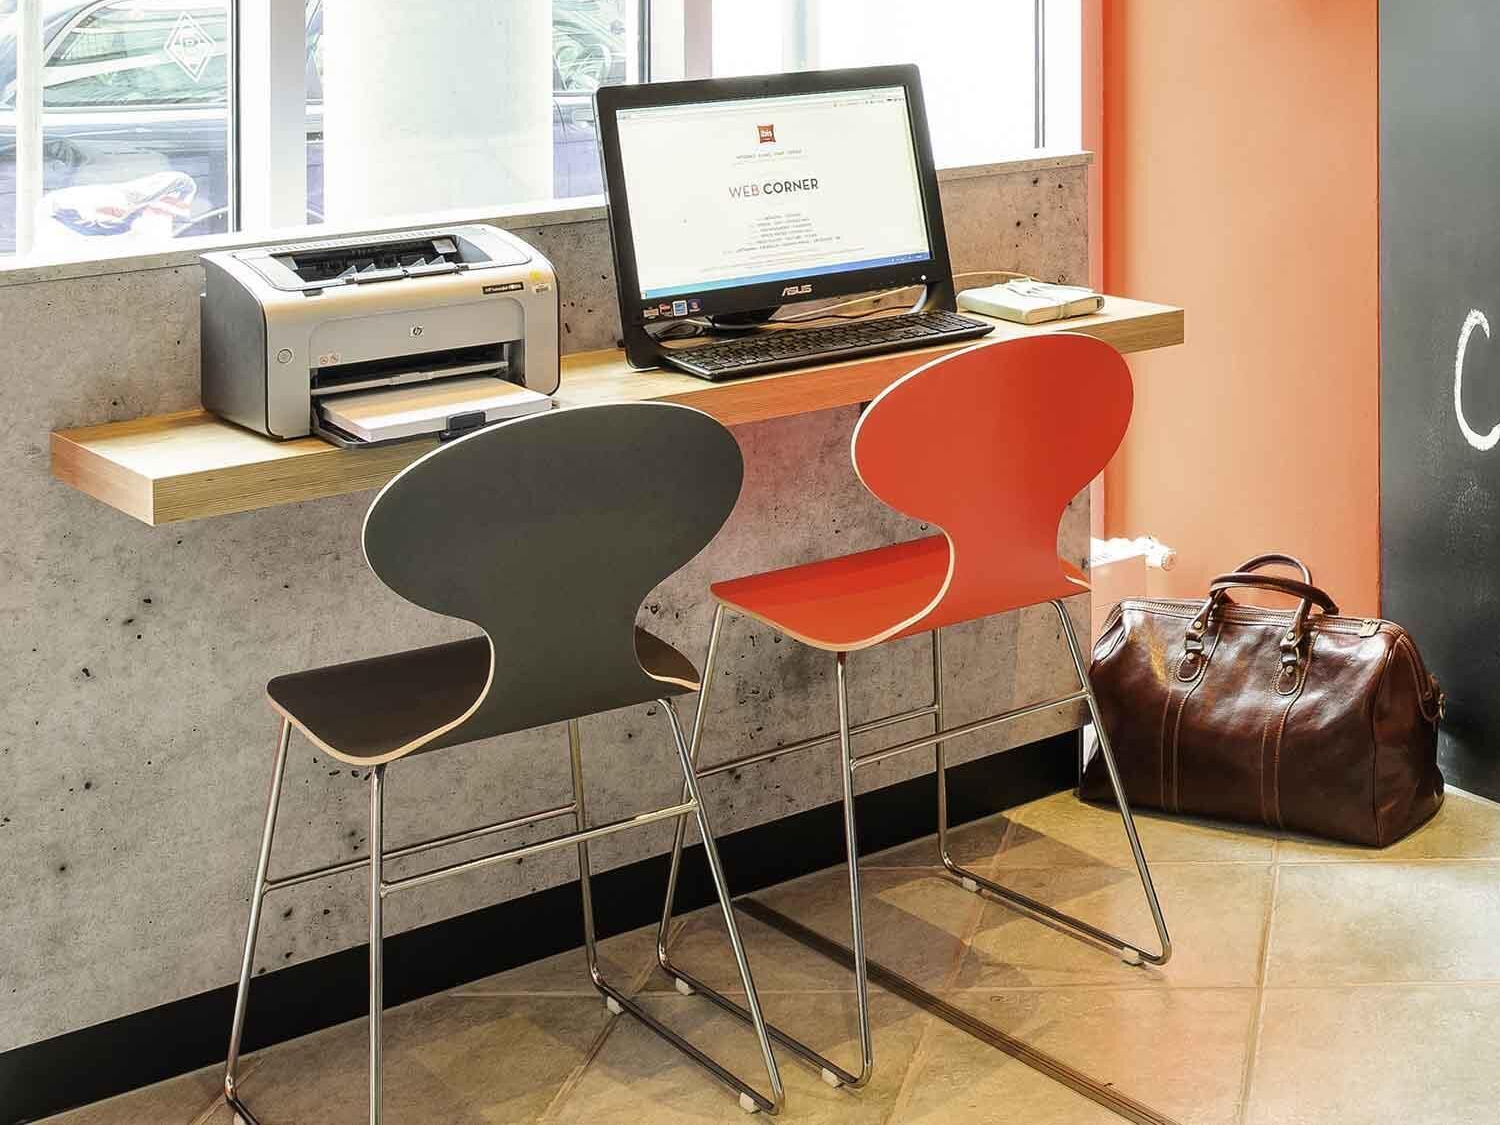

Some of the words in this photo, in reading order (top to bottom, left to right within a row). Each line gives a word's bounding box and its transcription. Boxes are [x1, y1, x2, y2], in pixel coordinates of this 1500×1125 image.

[728, 184, 760, 199] WEB
[762, 177, 819, 195] CORNER
[781, 284, 812, 297] ASUS
